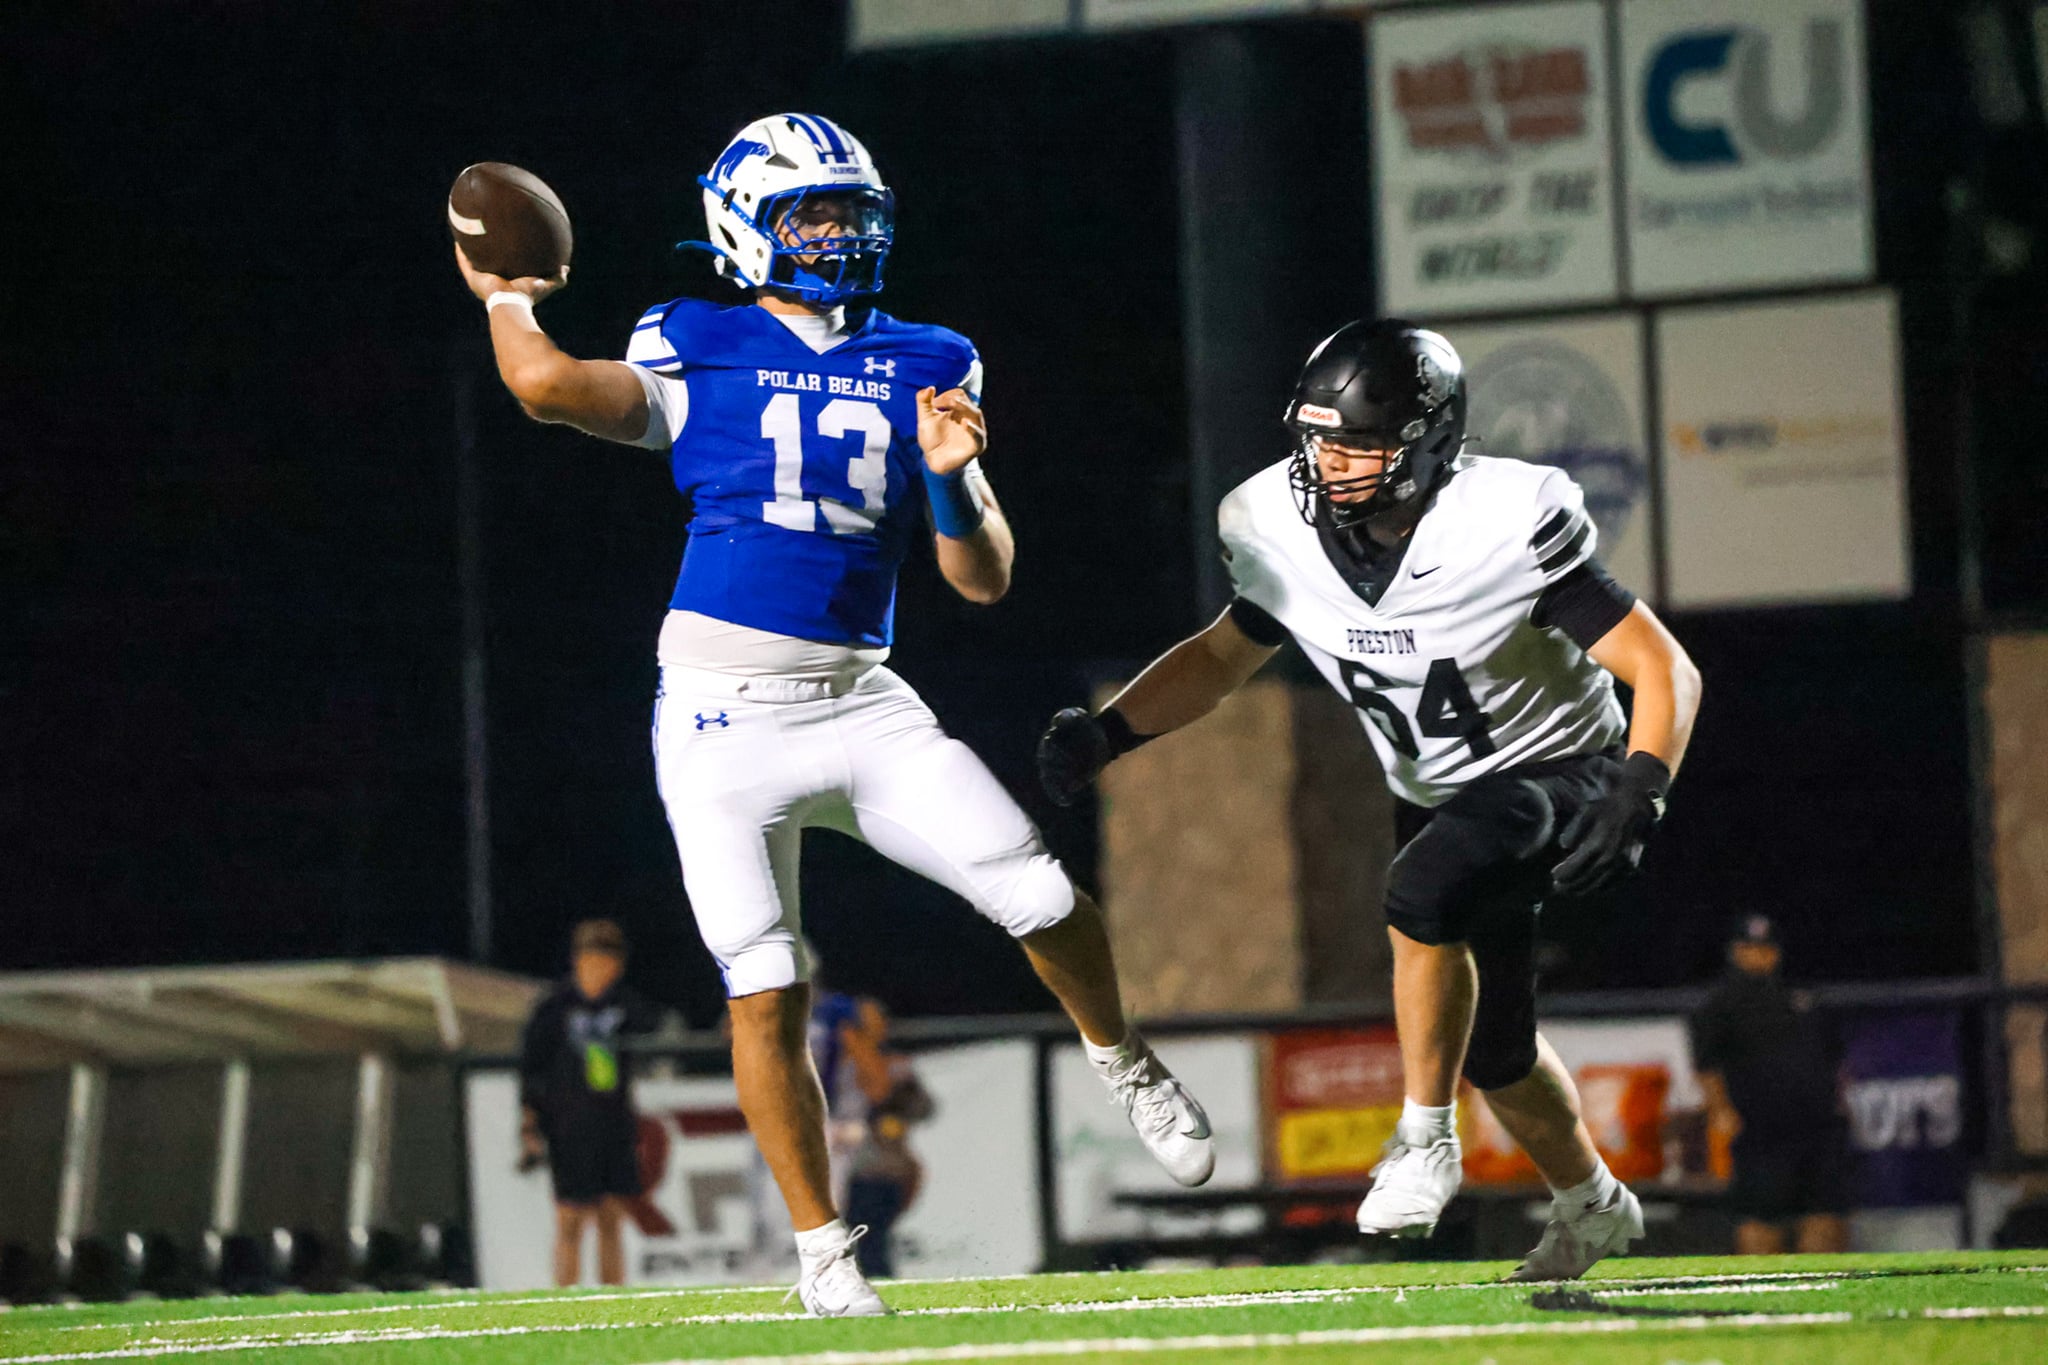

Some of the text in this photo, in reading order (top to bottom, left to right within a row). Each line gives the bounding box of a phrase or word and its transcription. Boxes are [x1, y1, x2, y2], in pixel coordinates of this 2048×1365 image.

[1644, 20, 1845, 171] CU
[756, 369, 891, 401] POLAR BEARS
[760, 392, 892, 535] 13
[1346, 628, 1417, 654] PRESTON
[1337, 656, 1497, 762] 64
